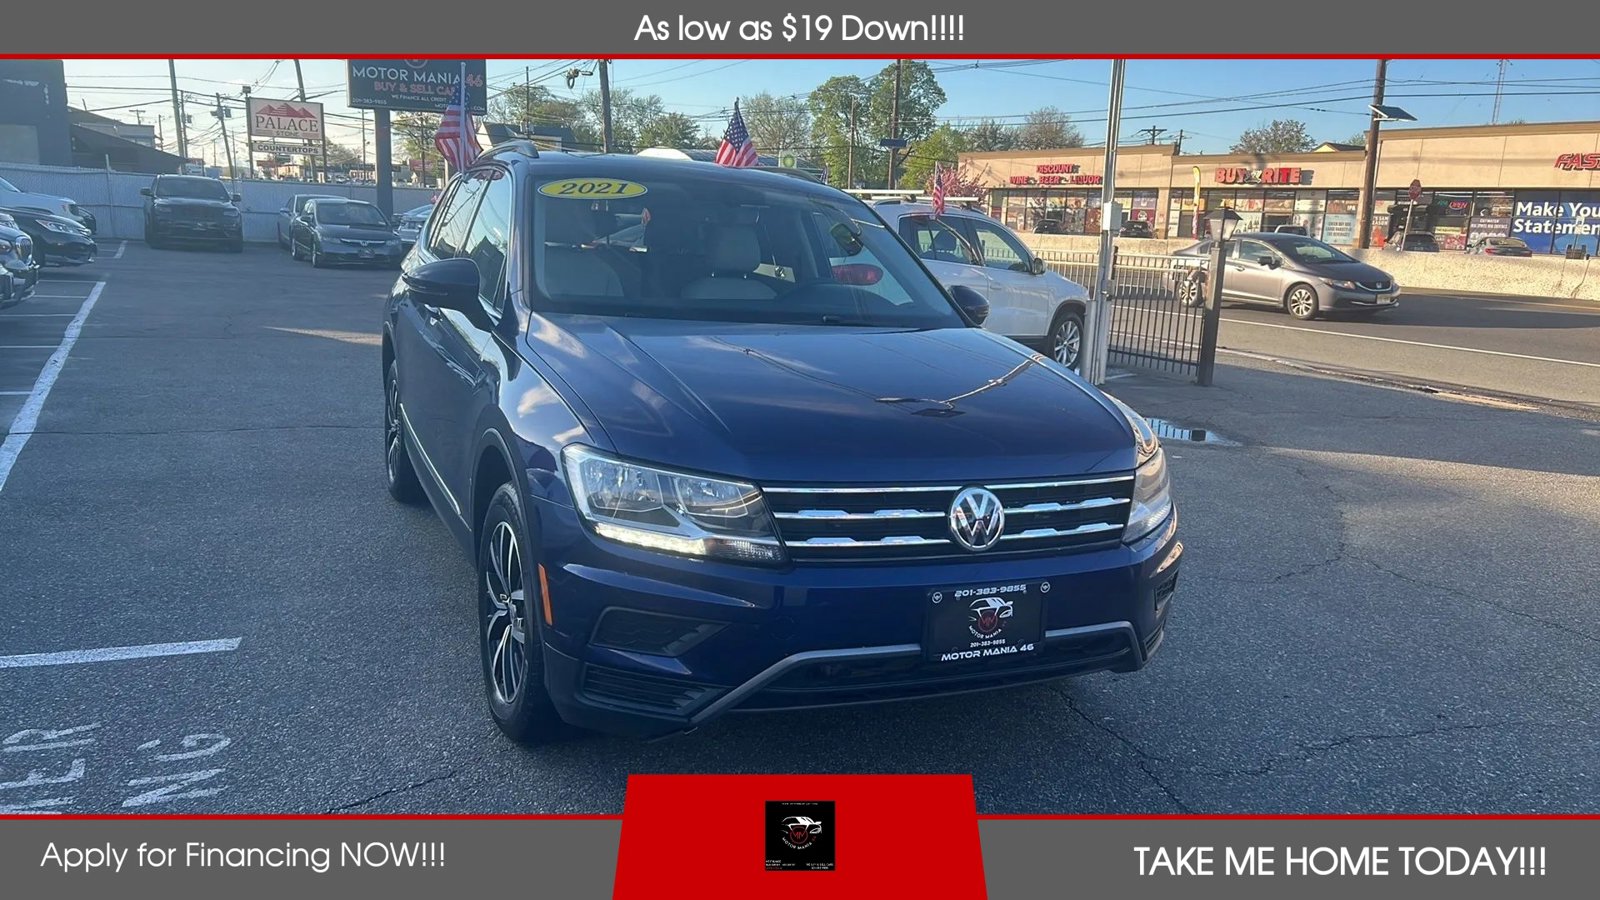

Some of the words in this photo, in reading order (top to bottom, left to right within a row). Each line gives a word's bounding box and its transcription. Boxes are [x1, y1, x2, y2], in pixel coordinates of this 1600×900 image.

[353, 66, 408, 81] MOTOR
[414, 71, 460, 84] MANIA
[465, 74, 483, 87] 46
[374, 82, 396, 92] BUY
[399, 83, 407, 93] &
[409, 84, 434, 94] SELL
[436, 86, 455, 96] CAR
[255, 115, 319, 133] PALACE
[257, 144, 319, 154] COUNTERTOPS
[1554, 153, 1600, 170] FAS
[1037, 164, 1074, 174] DISCOUNT
[1215, 168, 1247, 184] BUY
[1262, 168, 1301, 184] RITE
[1010, 176, 1029, 185] WINE
[1039, 175, 1061, 184] BEER
[1070, 175, 1101, 185] LIQUOR
[558, 182, 628, 195] 2021
[1516, 201, 1564, 216] Make
[954, 584, 1027, 598] 201-383-9855
[969, 625, 984, 639] MOTOR
[985, 628, 1002, 639] MANIA
[970, 639, 1006, 648] 201-383-9855
[941, 650, 981, 661] MOTOR
[983, 646, 1018, 657] MANIA
[1019, 643, 1034, 651] 46
